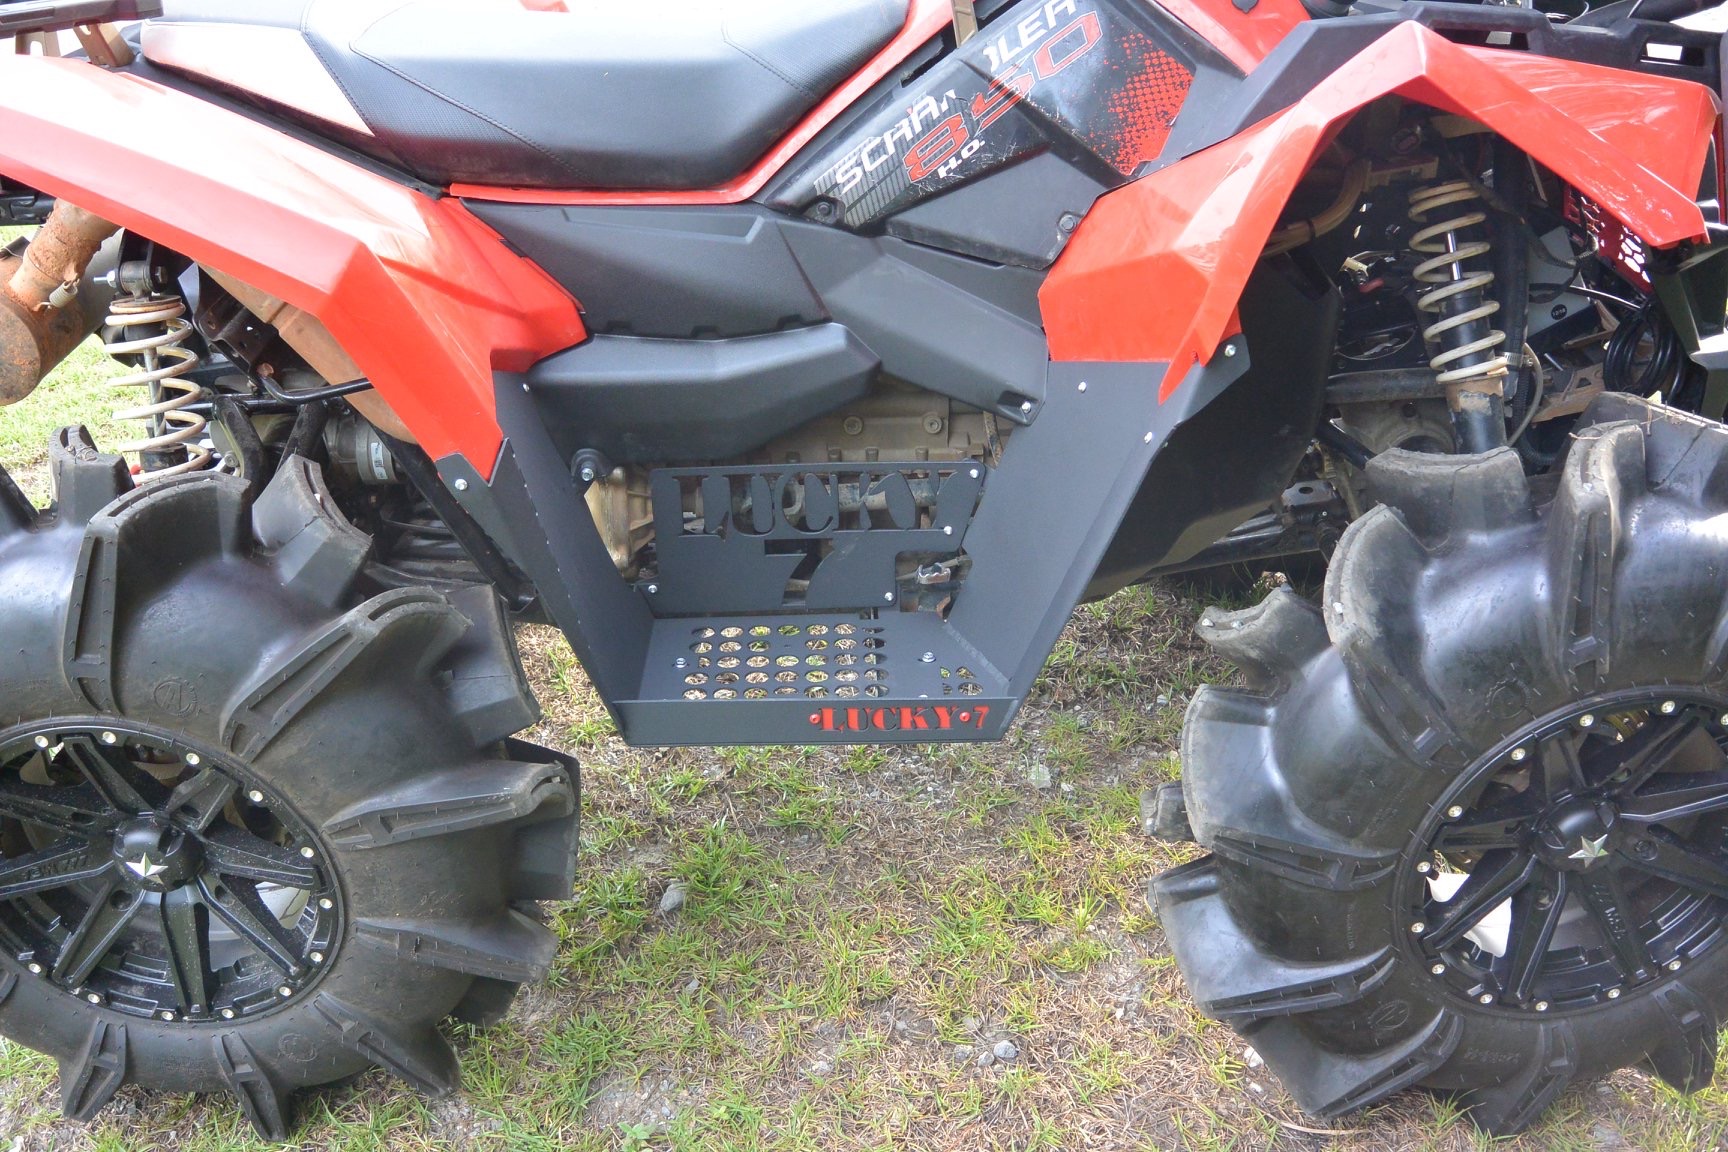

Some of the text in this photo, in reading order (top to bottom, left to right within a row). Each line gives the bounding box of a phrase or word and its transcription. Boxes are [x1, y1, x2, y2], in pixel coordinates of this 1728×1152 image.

[903, 10, 1103, 183] 850
[672, 470, 958, 541] LUCKY
[764, 537, 834, 607] 7
[819, 705, 990, 733] LUCKY 7
